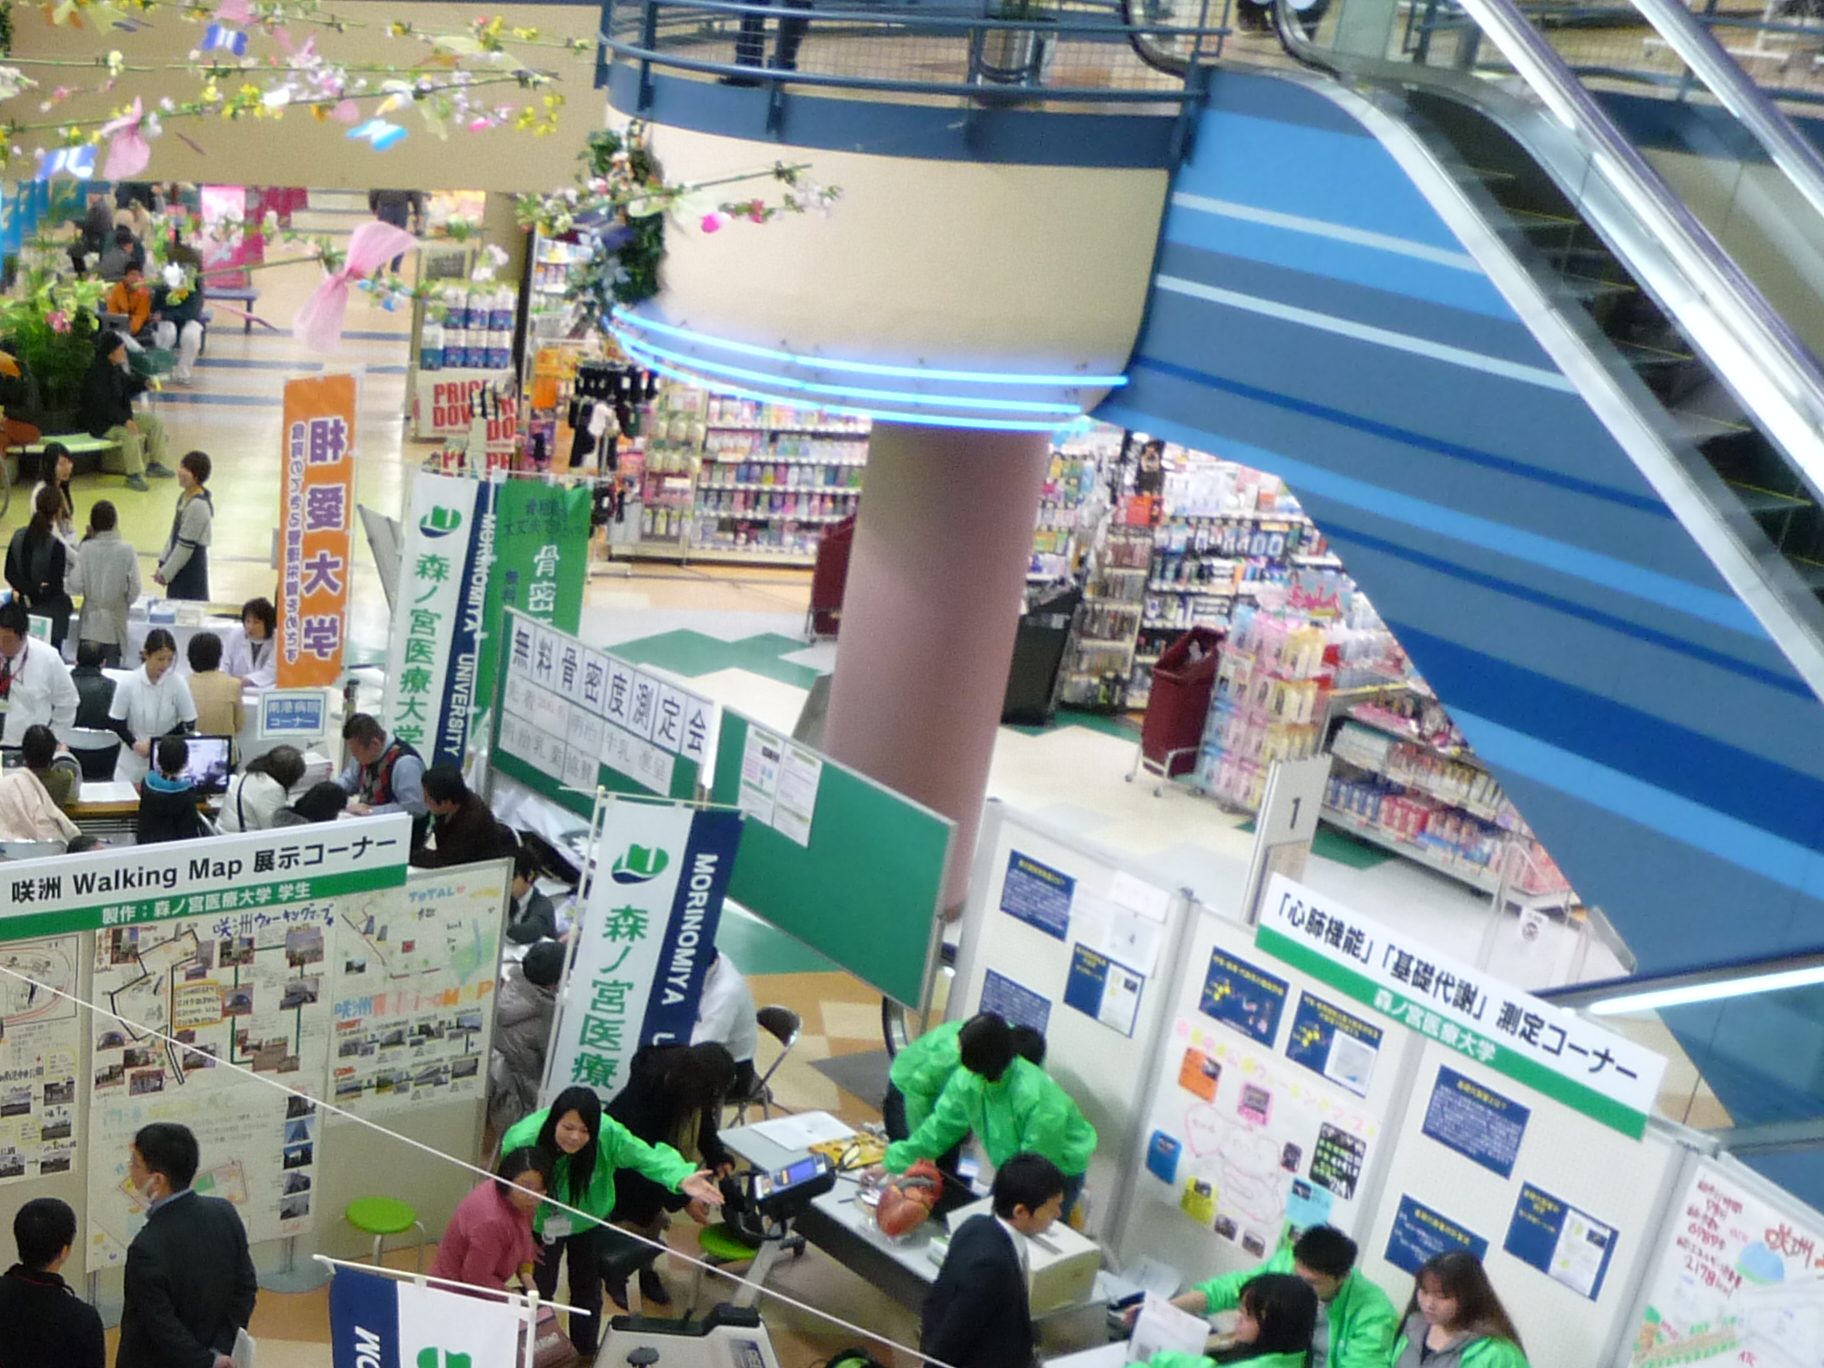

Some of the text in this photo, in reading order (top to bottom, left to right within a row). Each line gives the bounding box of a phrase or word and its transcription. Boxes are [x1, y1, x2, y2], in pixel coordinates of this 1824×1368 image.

[528, 545, 560, 625] 骨密
[392, 553, 451, 746] 森ノ宮医療大学
[443, 513, 497, 757] MORINOMIYA UNIVERSITY
[269, 716, 316, 727] コーナー
[512, 626, 708, 756] 無料骨密度測定会
[1290, 797, 1301, 830] 1
[11, 837, 398, 903] 咲洲 Walking Map 展示コーナー
[279, 882, 312, 901] 学生
[661, 853, 719, 1006] MORINOMIYA
[570, 904, 650, 1090] 森ノ宮医療
[1374, 984, 1498, 1063] 森ノ宮医療大学
[1494, 999, 1639, 1081] 測定コーナー
